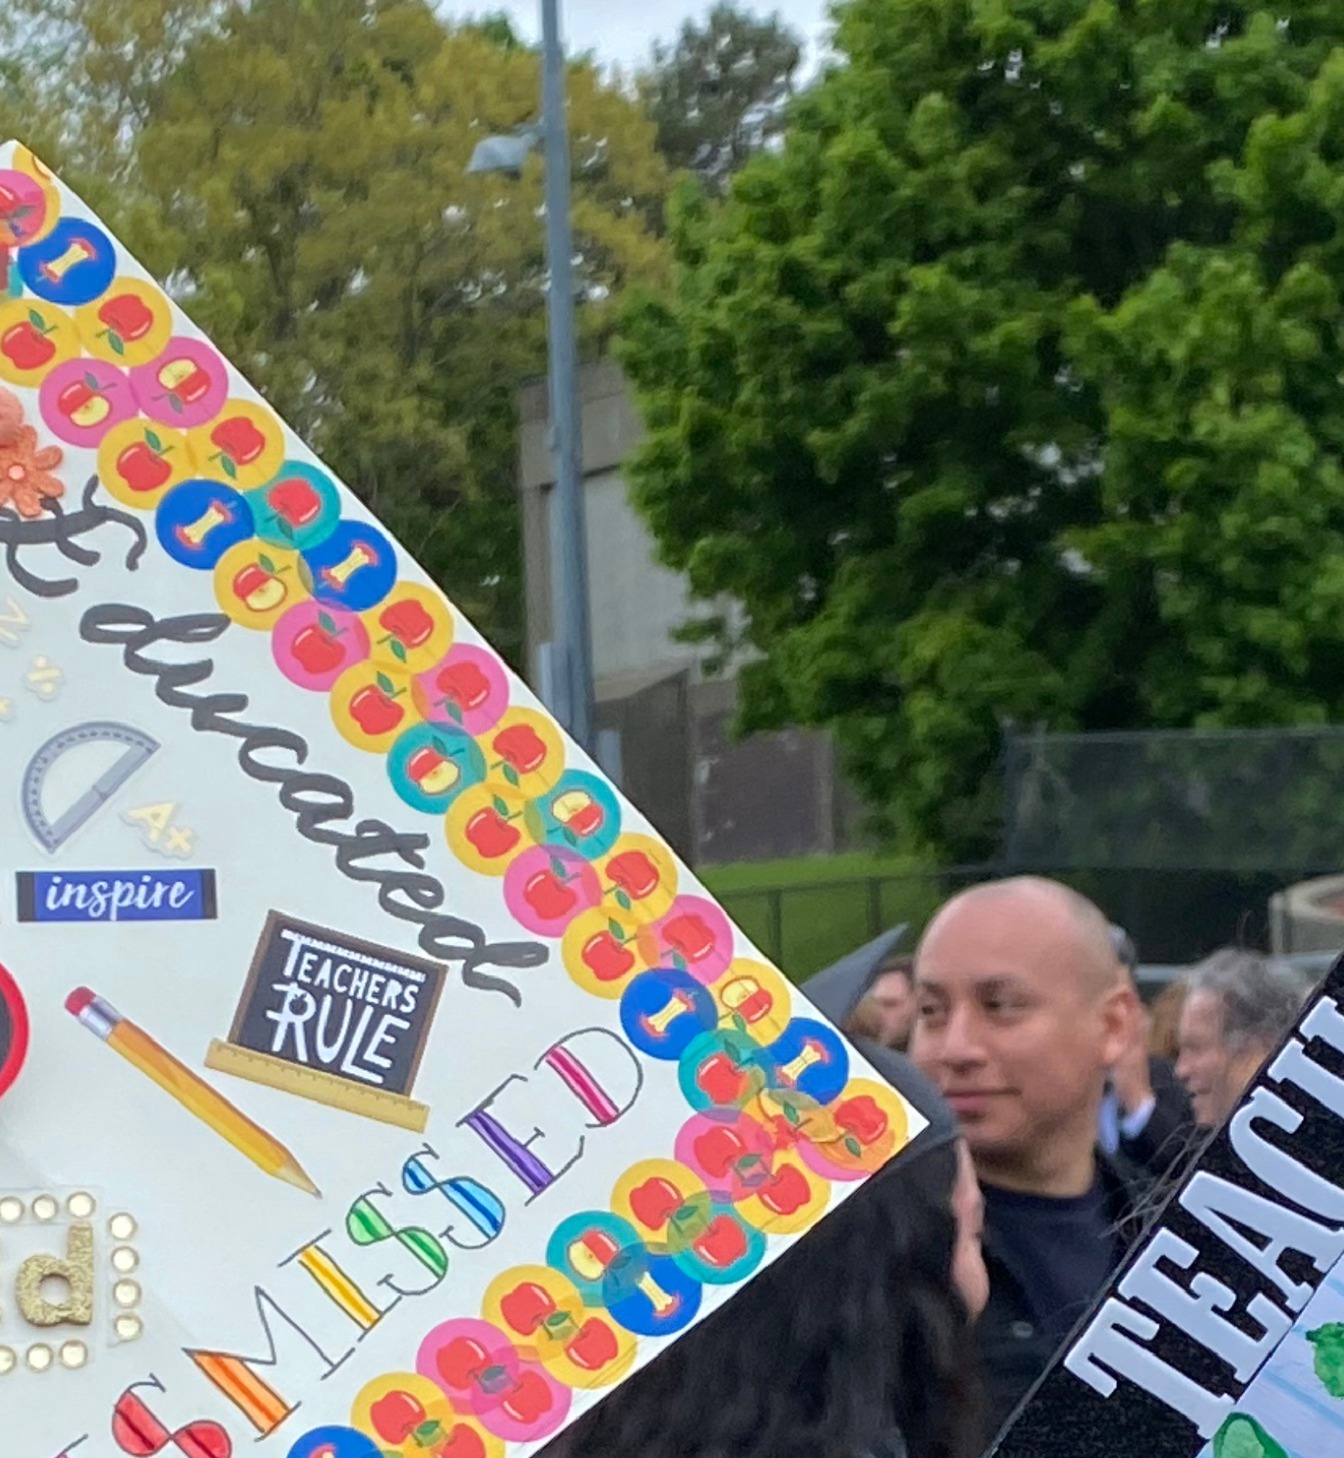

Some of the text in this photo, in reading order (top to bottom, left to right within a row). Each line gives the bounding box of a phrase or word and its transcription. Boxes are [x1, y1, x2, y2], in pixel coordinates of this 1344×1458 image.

[45, 876, 193, 921] inspire
[280, 928, 421, 1013] TEACHERS
[265, 980, 411, 1084] RULE
